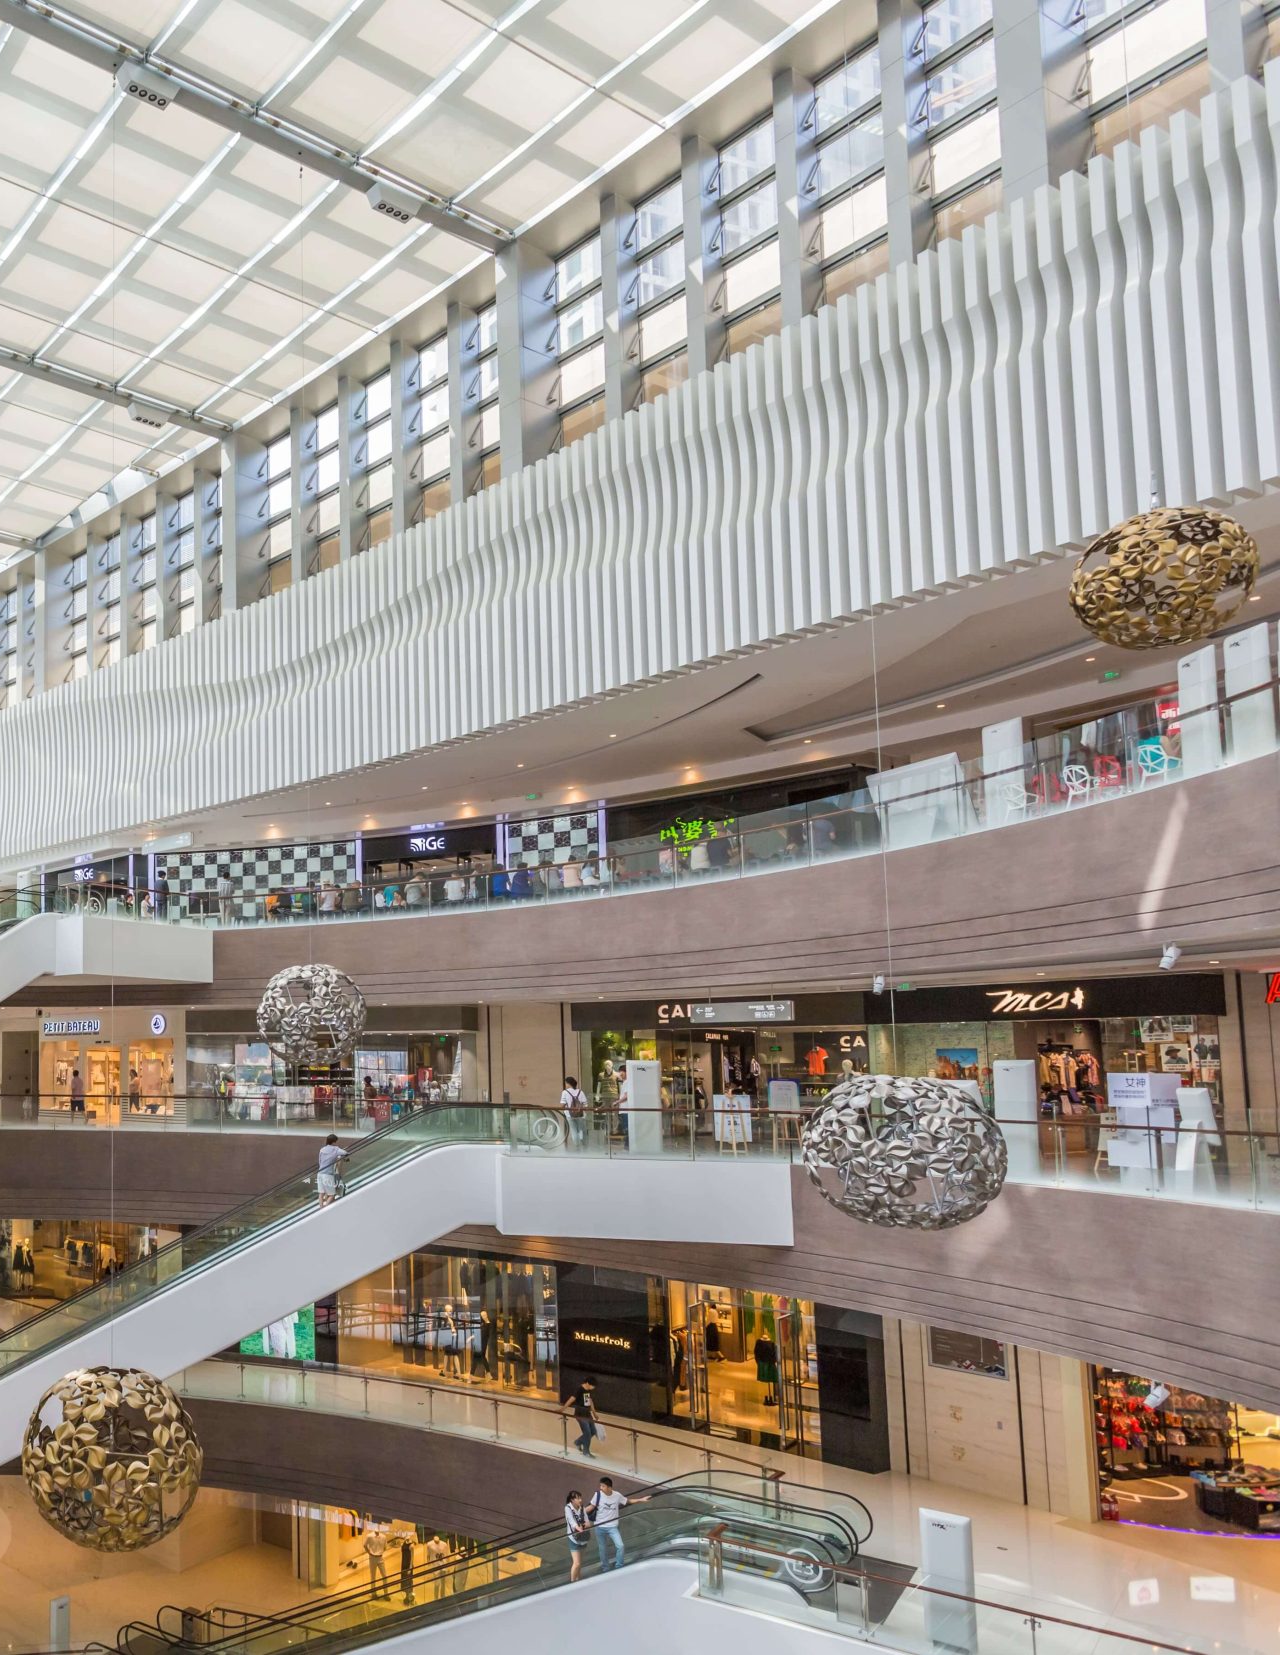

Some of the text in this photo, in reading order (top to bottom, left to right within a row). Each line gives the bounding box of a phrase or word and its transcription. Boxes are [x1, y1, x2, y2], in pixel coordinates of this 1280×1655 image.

[657, 1004, 691, 1019] CA
[43, 1020, 99, 1032] PETIT BATEAU
[1125, 1078, 1146, 1088] 女神
[574, 1331, 631, 1350] Marisfrolg
